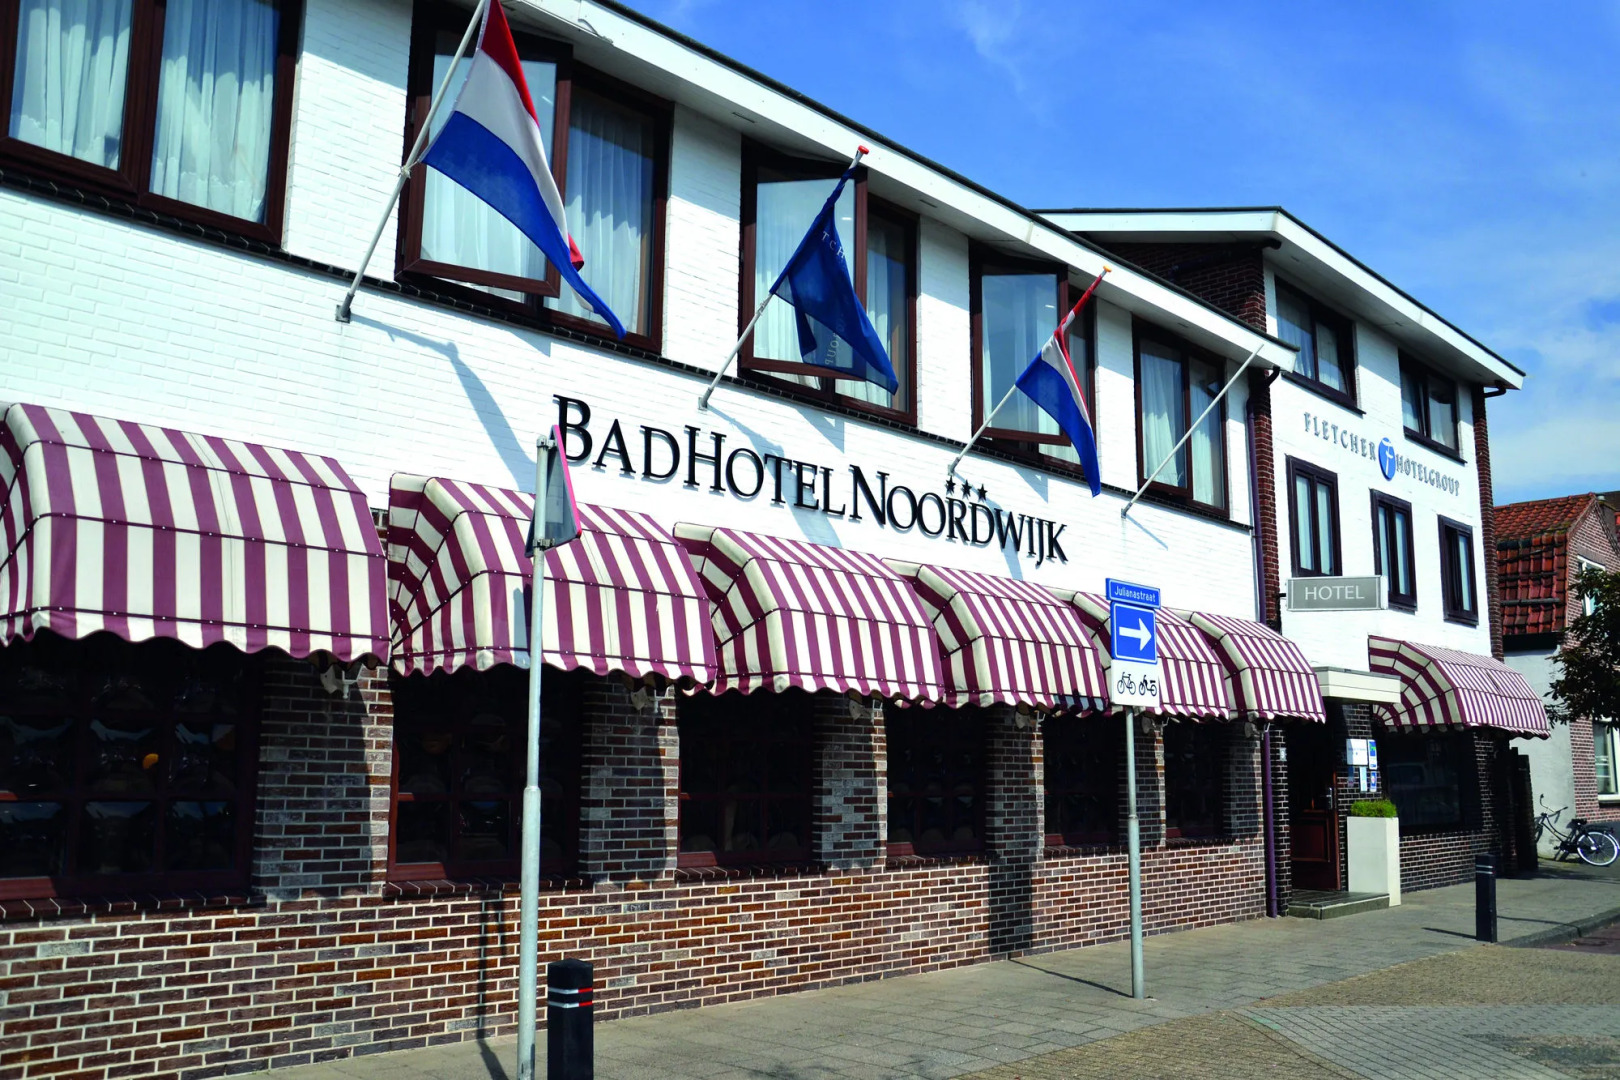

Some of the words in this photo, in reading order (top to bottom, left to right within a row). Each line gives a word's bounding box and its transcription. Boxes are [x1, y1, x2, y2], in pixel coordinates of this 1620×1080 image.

[1303, 411, 1377, 461] FLETCHER
[1395, 453, 1460, 497] HOTELGROUP
[1114, 585, 1156, 603] Julianastraat
[1304, 585, 1365, 600] HOTEL
